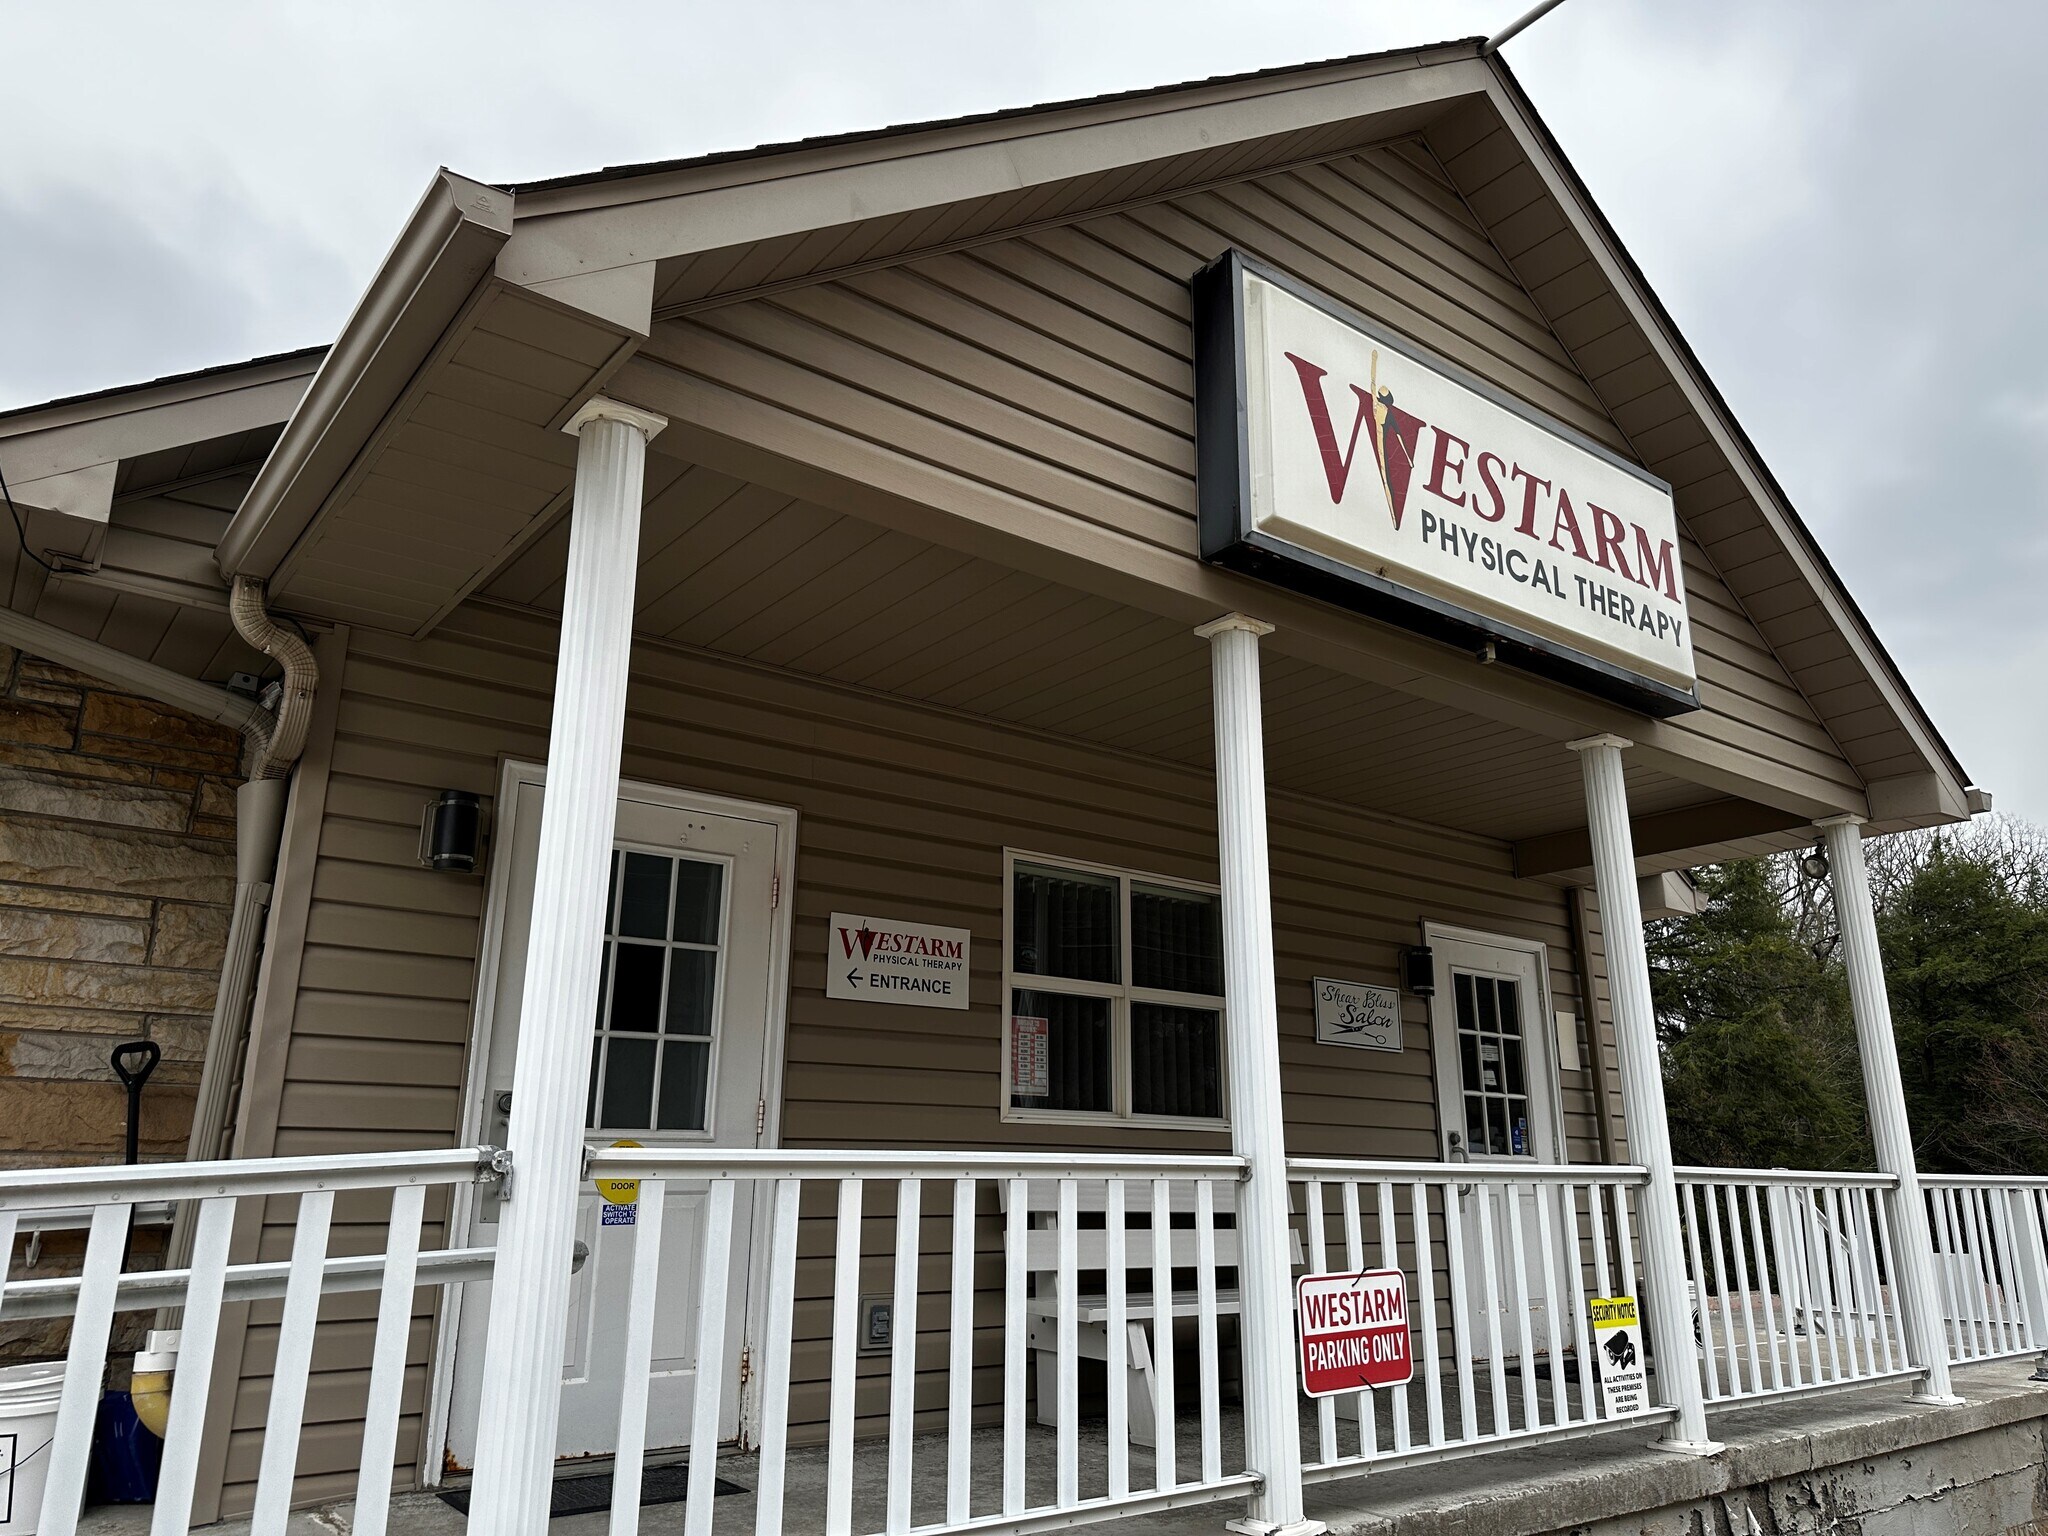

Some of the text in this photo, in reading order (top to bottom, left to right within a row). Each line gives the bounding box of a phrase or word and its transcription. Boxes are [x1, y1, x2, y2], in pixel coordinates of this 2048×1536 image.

[1284, 351, 1682, 604] WESTARM
[1421, 508, 1682, 648] PHYSICAL THERAPY
[837, 926, 963, 961] WESTARM
[873, 954, 962, 971] PHYSICAL THERAPY
[870, 973, 951, 995] ENTRANCE
[1321, 985, 1396, 1009] Shear Bliss
[1338, 1004, 1394, 1028] Salon
[1305, 1287, 1402, 1329] WESTARM
[1592, 1302, 1635, 1321] SECURITY NOTICE
[1308, 1332, 1404, 1372] PARKING ONLY
[1607, 1383, 1642, 1394] THESE PREMISES
[1613, 1373, 1635, 1382] ACTIVITIES
[1616, 1404, 1639, 1414] RECORDED
[1624, 1394, 1638, 1402] BEING
